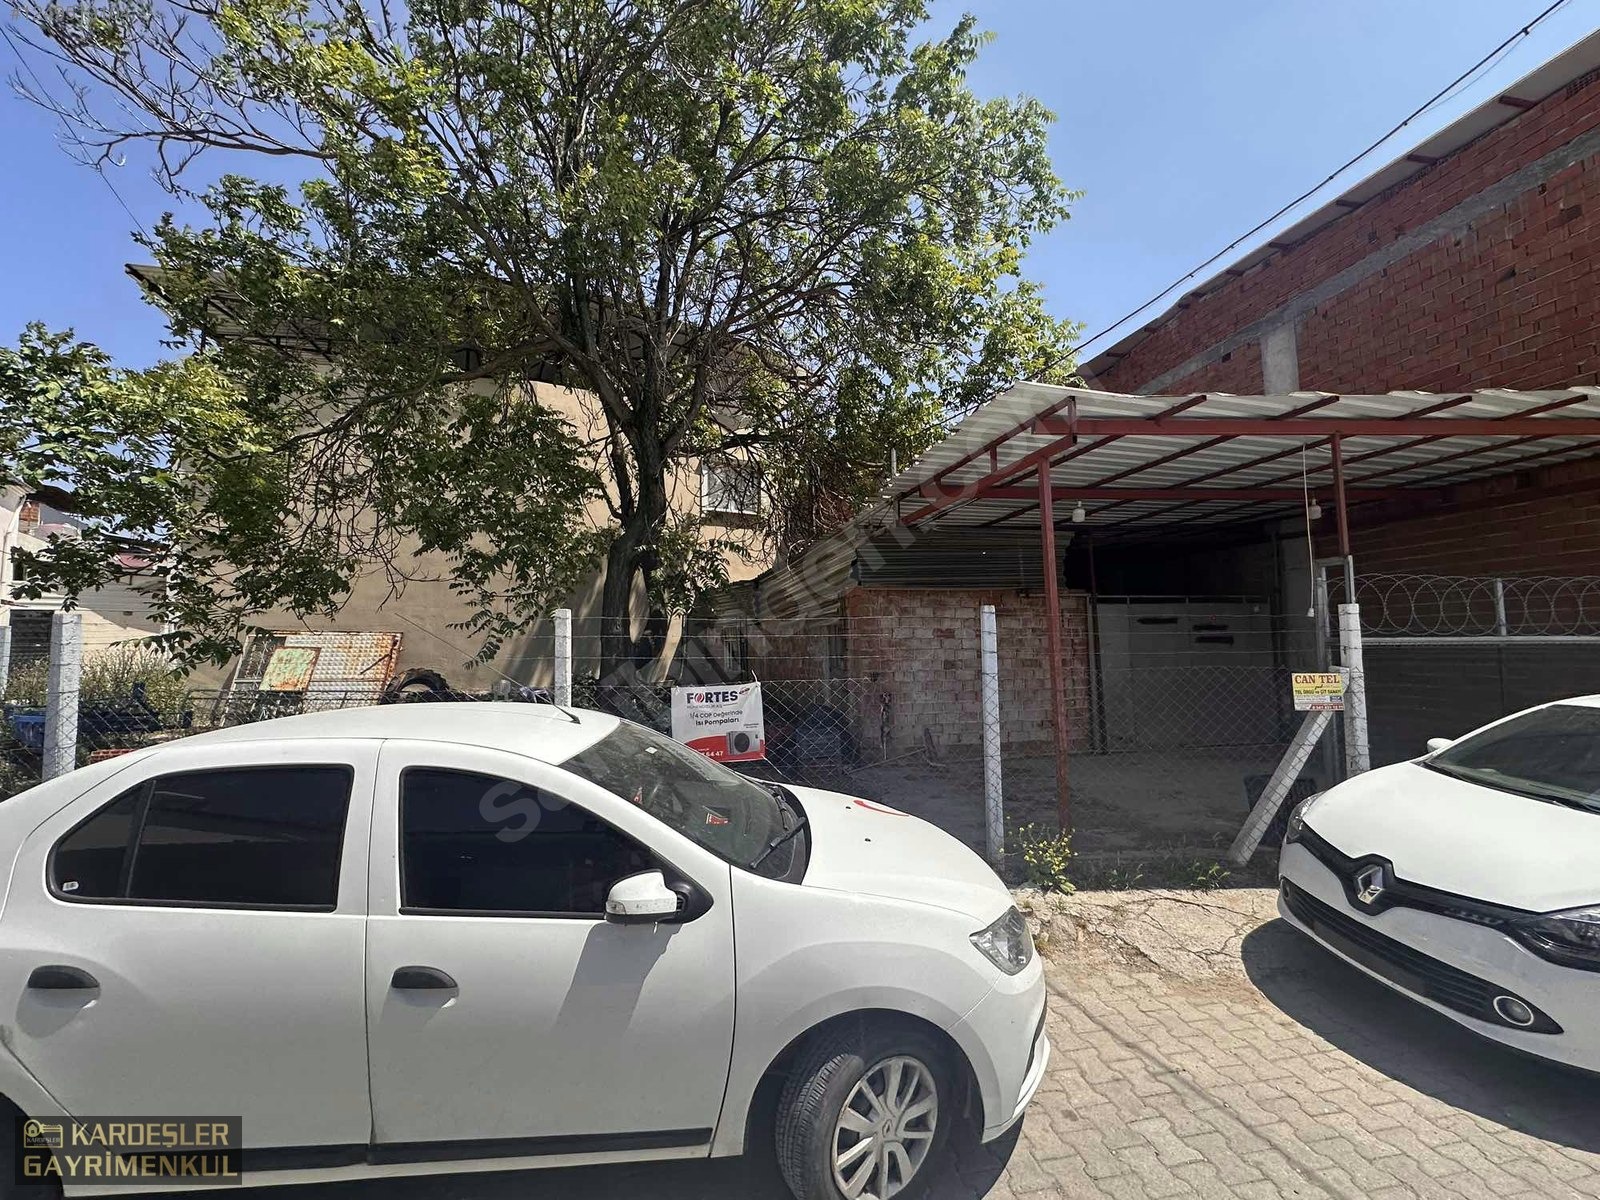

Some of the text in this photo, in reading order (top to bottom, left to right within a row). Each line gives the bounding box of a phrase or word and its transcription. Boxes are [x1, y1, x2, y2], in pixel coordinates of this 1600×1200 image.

[1295, 675, 1339, 684] CAN TEL
[687, 691, 738, 703] FORTES
